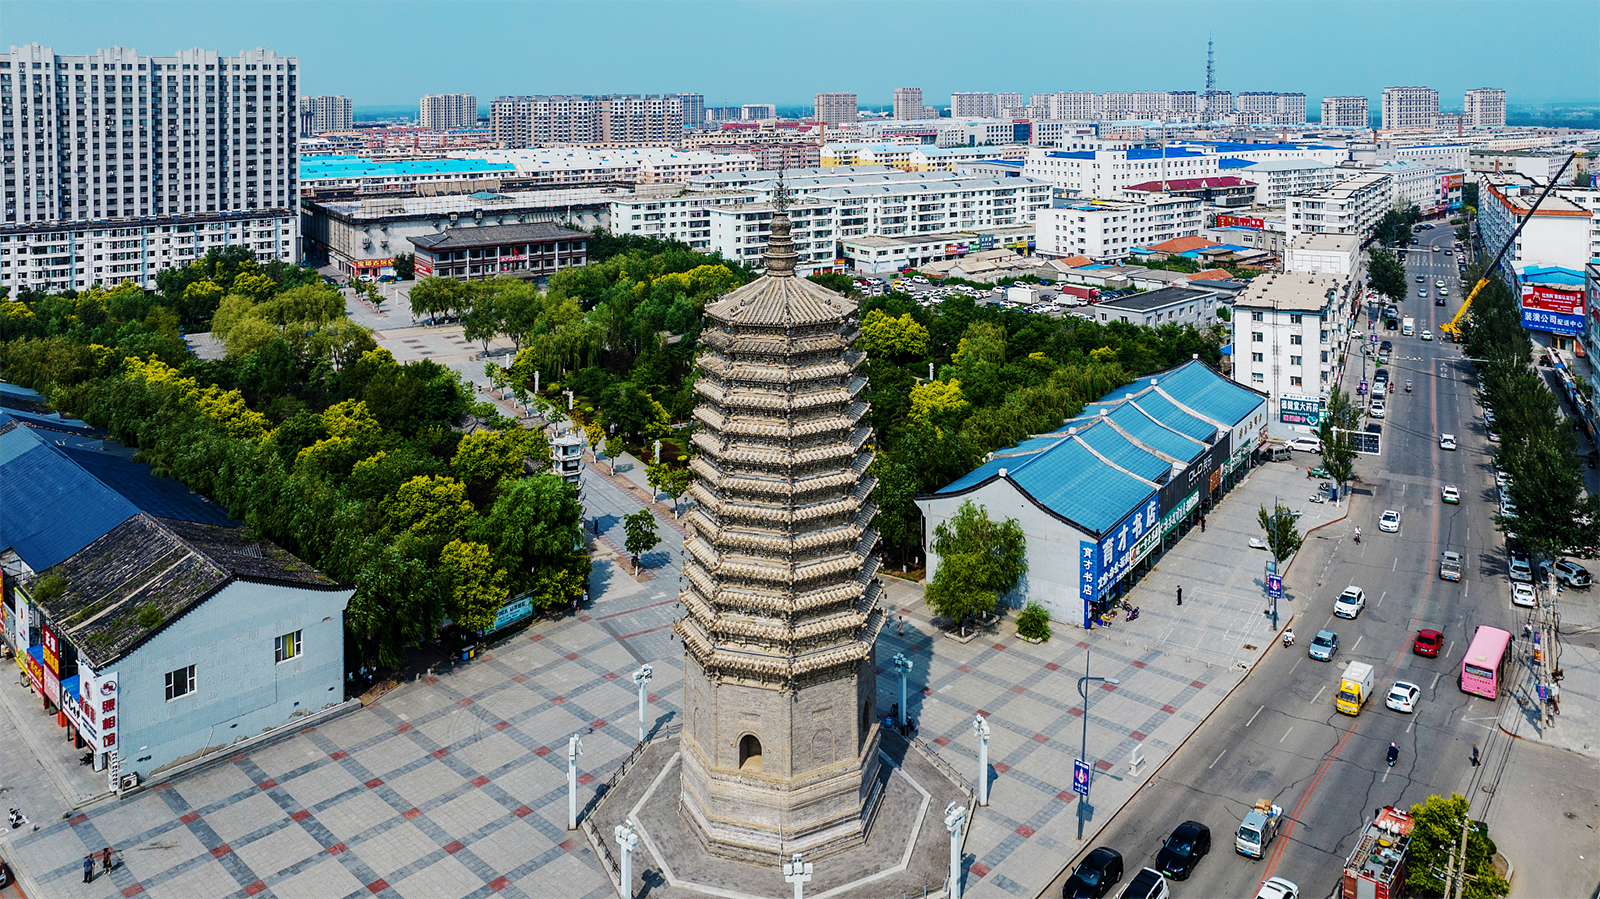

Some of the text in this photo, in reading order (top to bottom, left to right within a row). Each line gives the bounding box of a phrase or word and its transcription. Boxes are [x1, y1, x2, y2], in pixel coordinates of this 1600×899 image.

[1102, 500, 1156, 567] 育才书店
[1082, 547, 1093, 596] 育才书店
[102, 698, 116, 748] 照相馆
